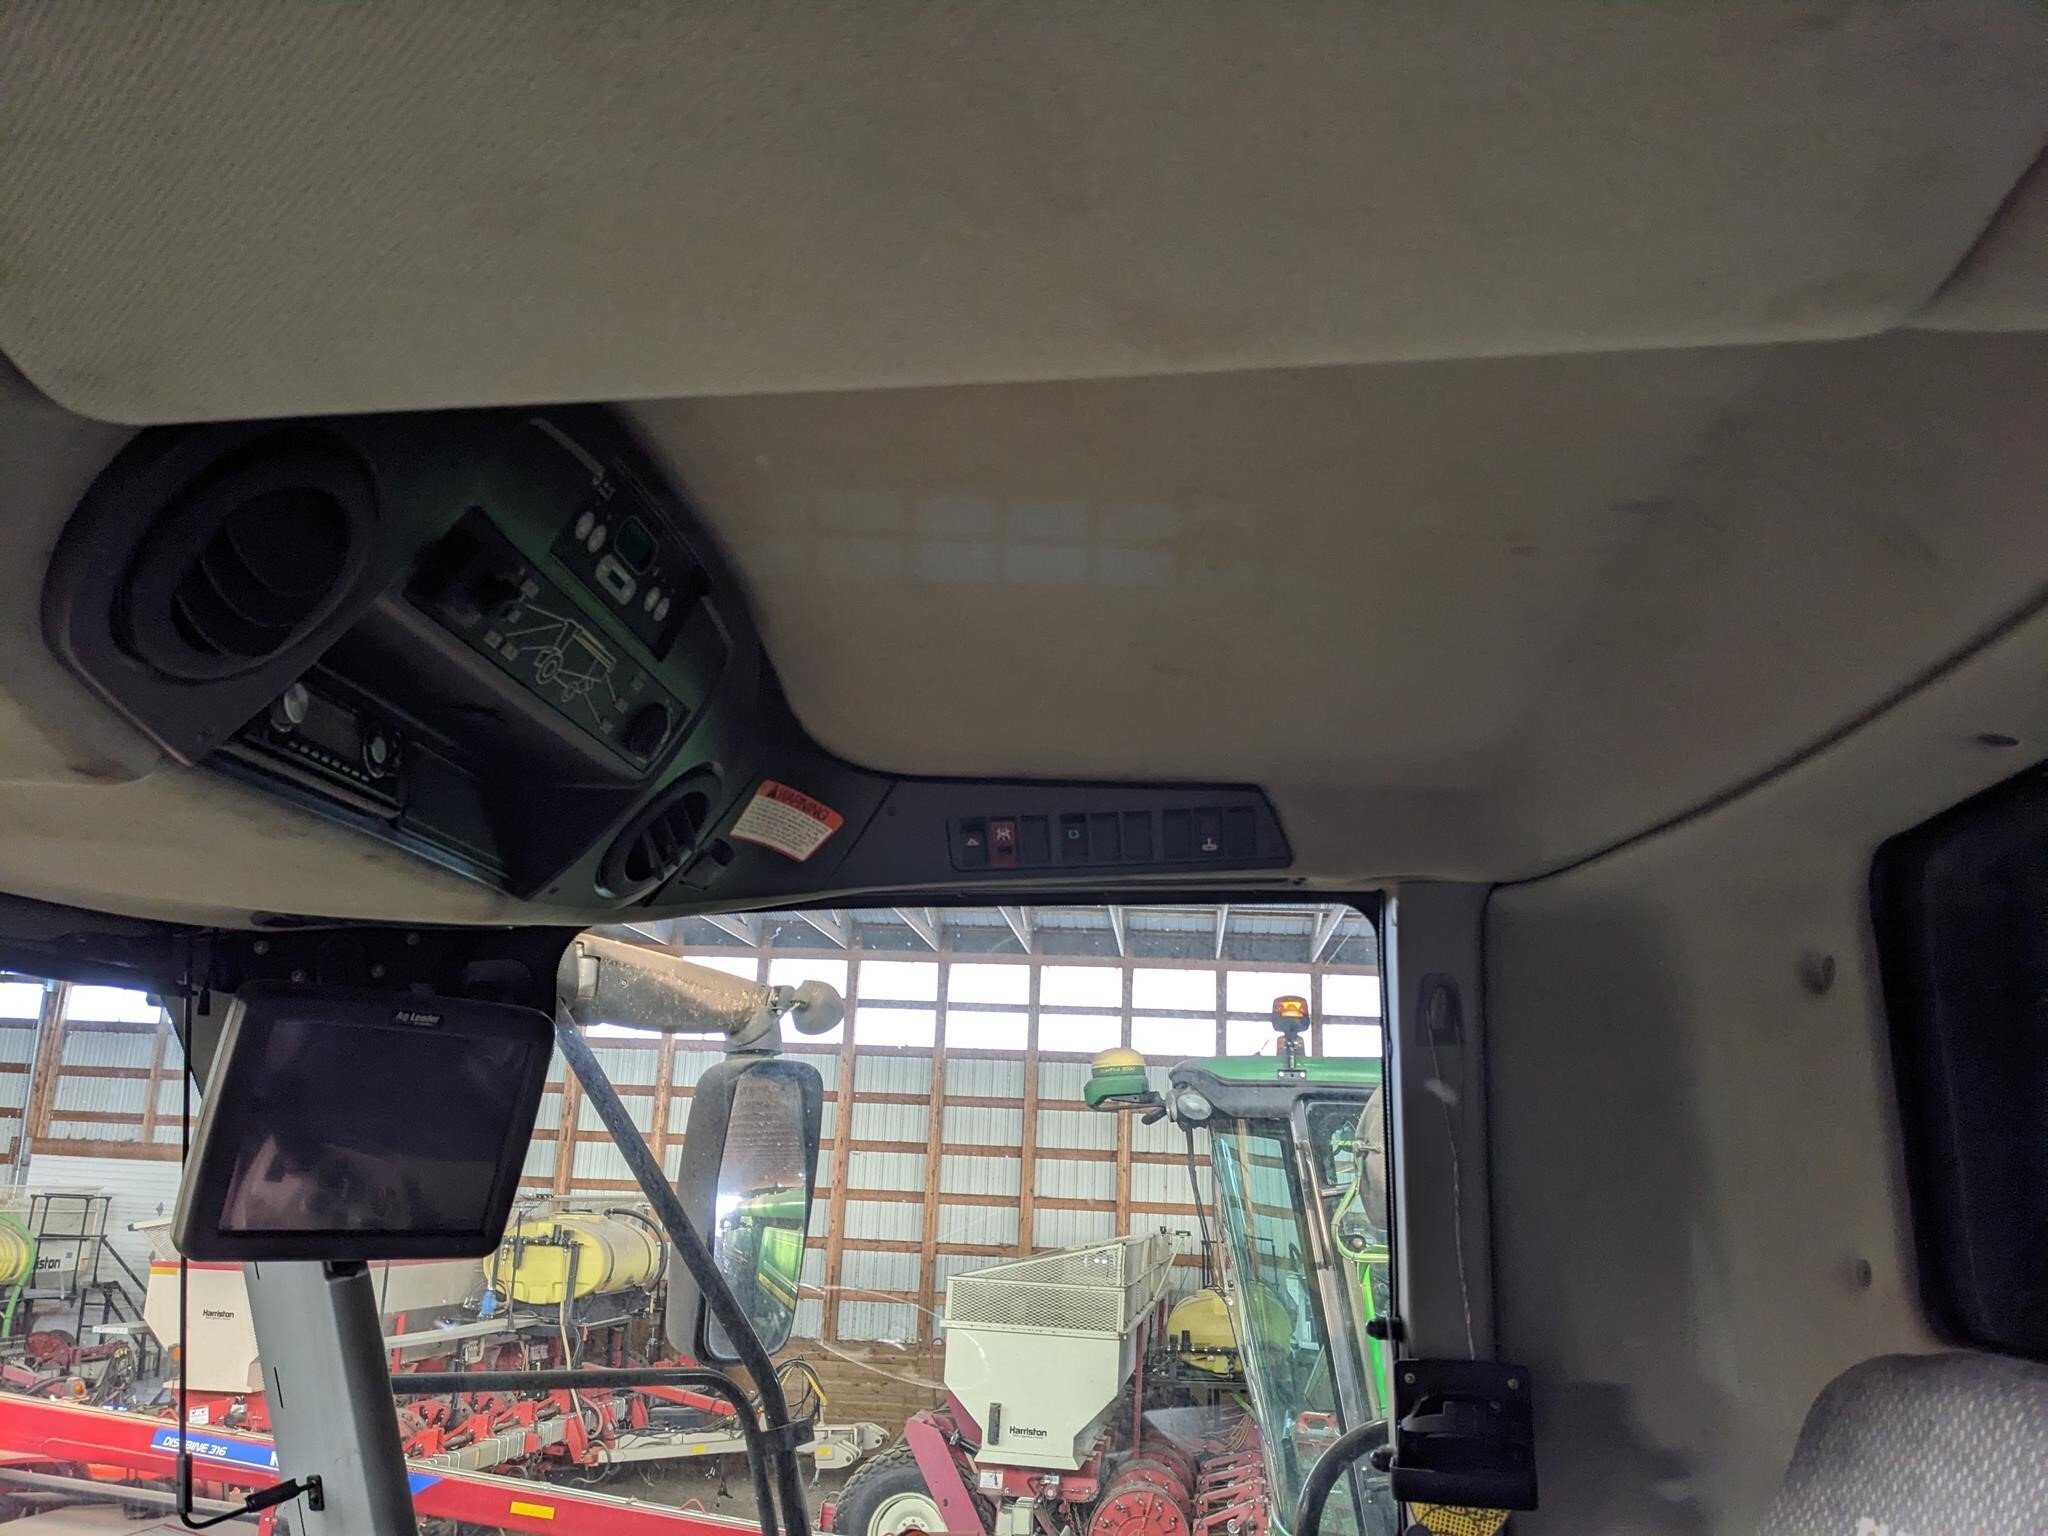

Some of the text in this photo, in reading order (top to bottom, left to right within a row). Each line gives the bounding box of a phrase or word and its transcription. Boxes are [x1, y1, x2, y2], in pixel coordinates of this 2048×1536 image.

[775, 785, 829, 820] WARNING
[203, 1308, 234, 1319] Harriston
[1009, 1426, 1047, 1437] Harriston
[163, 1436, 228, 1456] DISBINE 316
